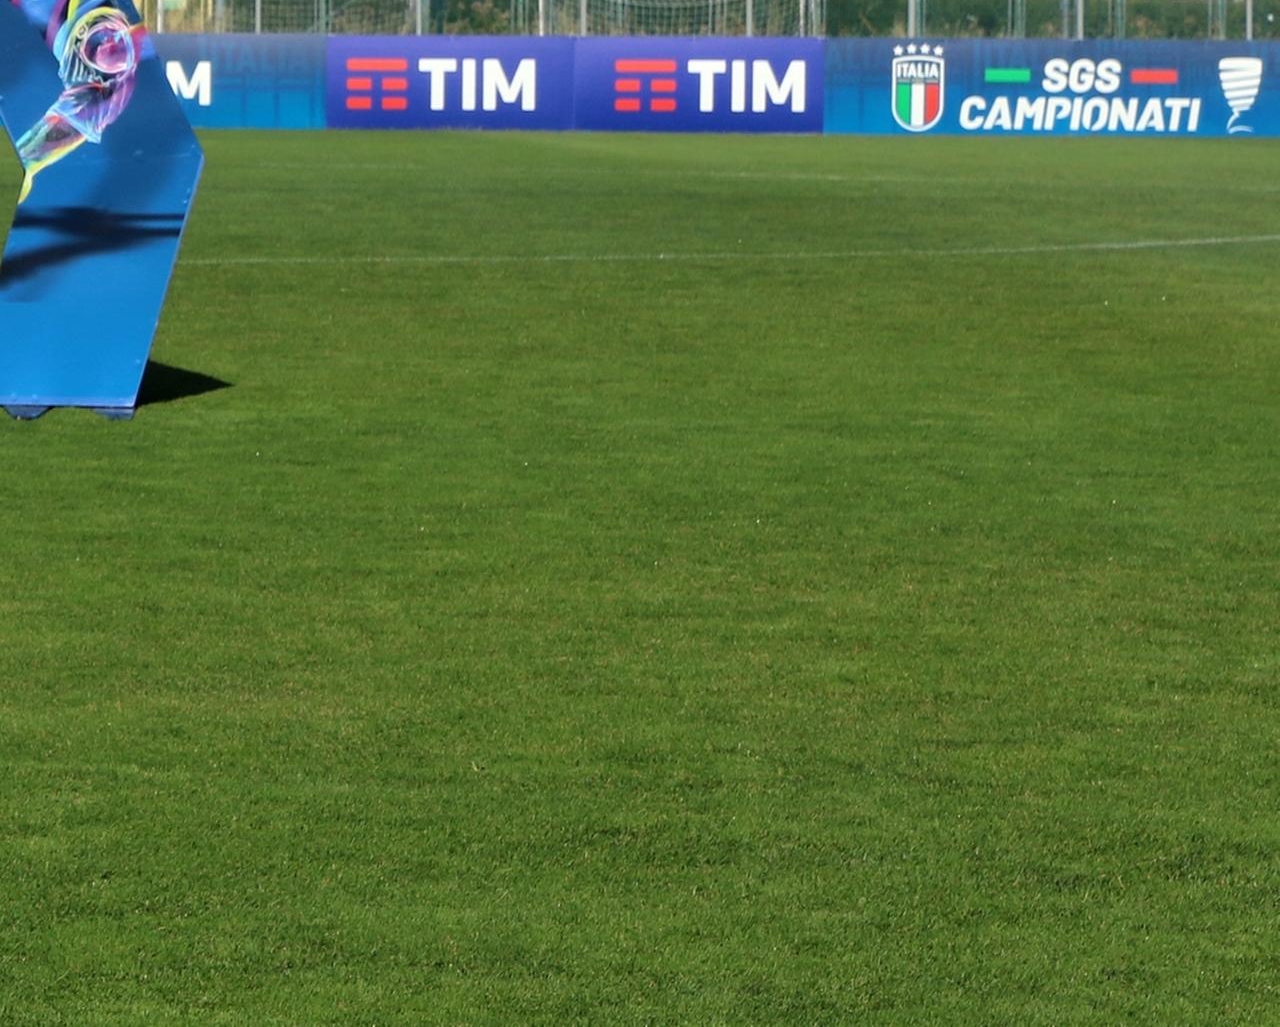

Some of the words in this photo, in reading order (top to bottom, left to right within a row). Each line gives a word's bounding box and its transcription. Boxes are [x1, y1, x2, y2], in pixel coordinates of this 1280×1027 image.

[418, 58, 536, 111] TIM
[687, 59, 806, 113] TIM
[896, 62, 939, 78] ITALIA
[1042, 58, 1122, 94] SGS
[959, 96, 1202, 132] CAMPIONATI
